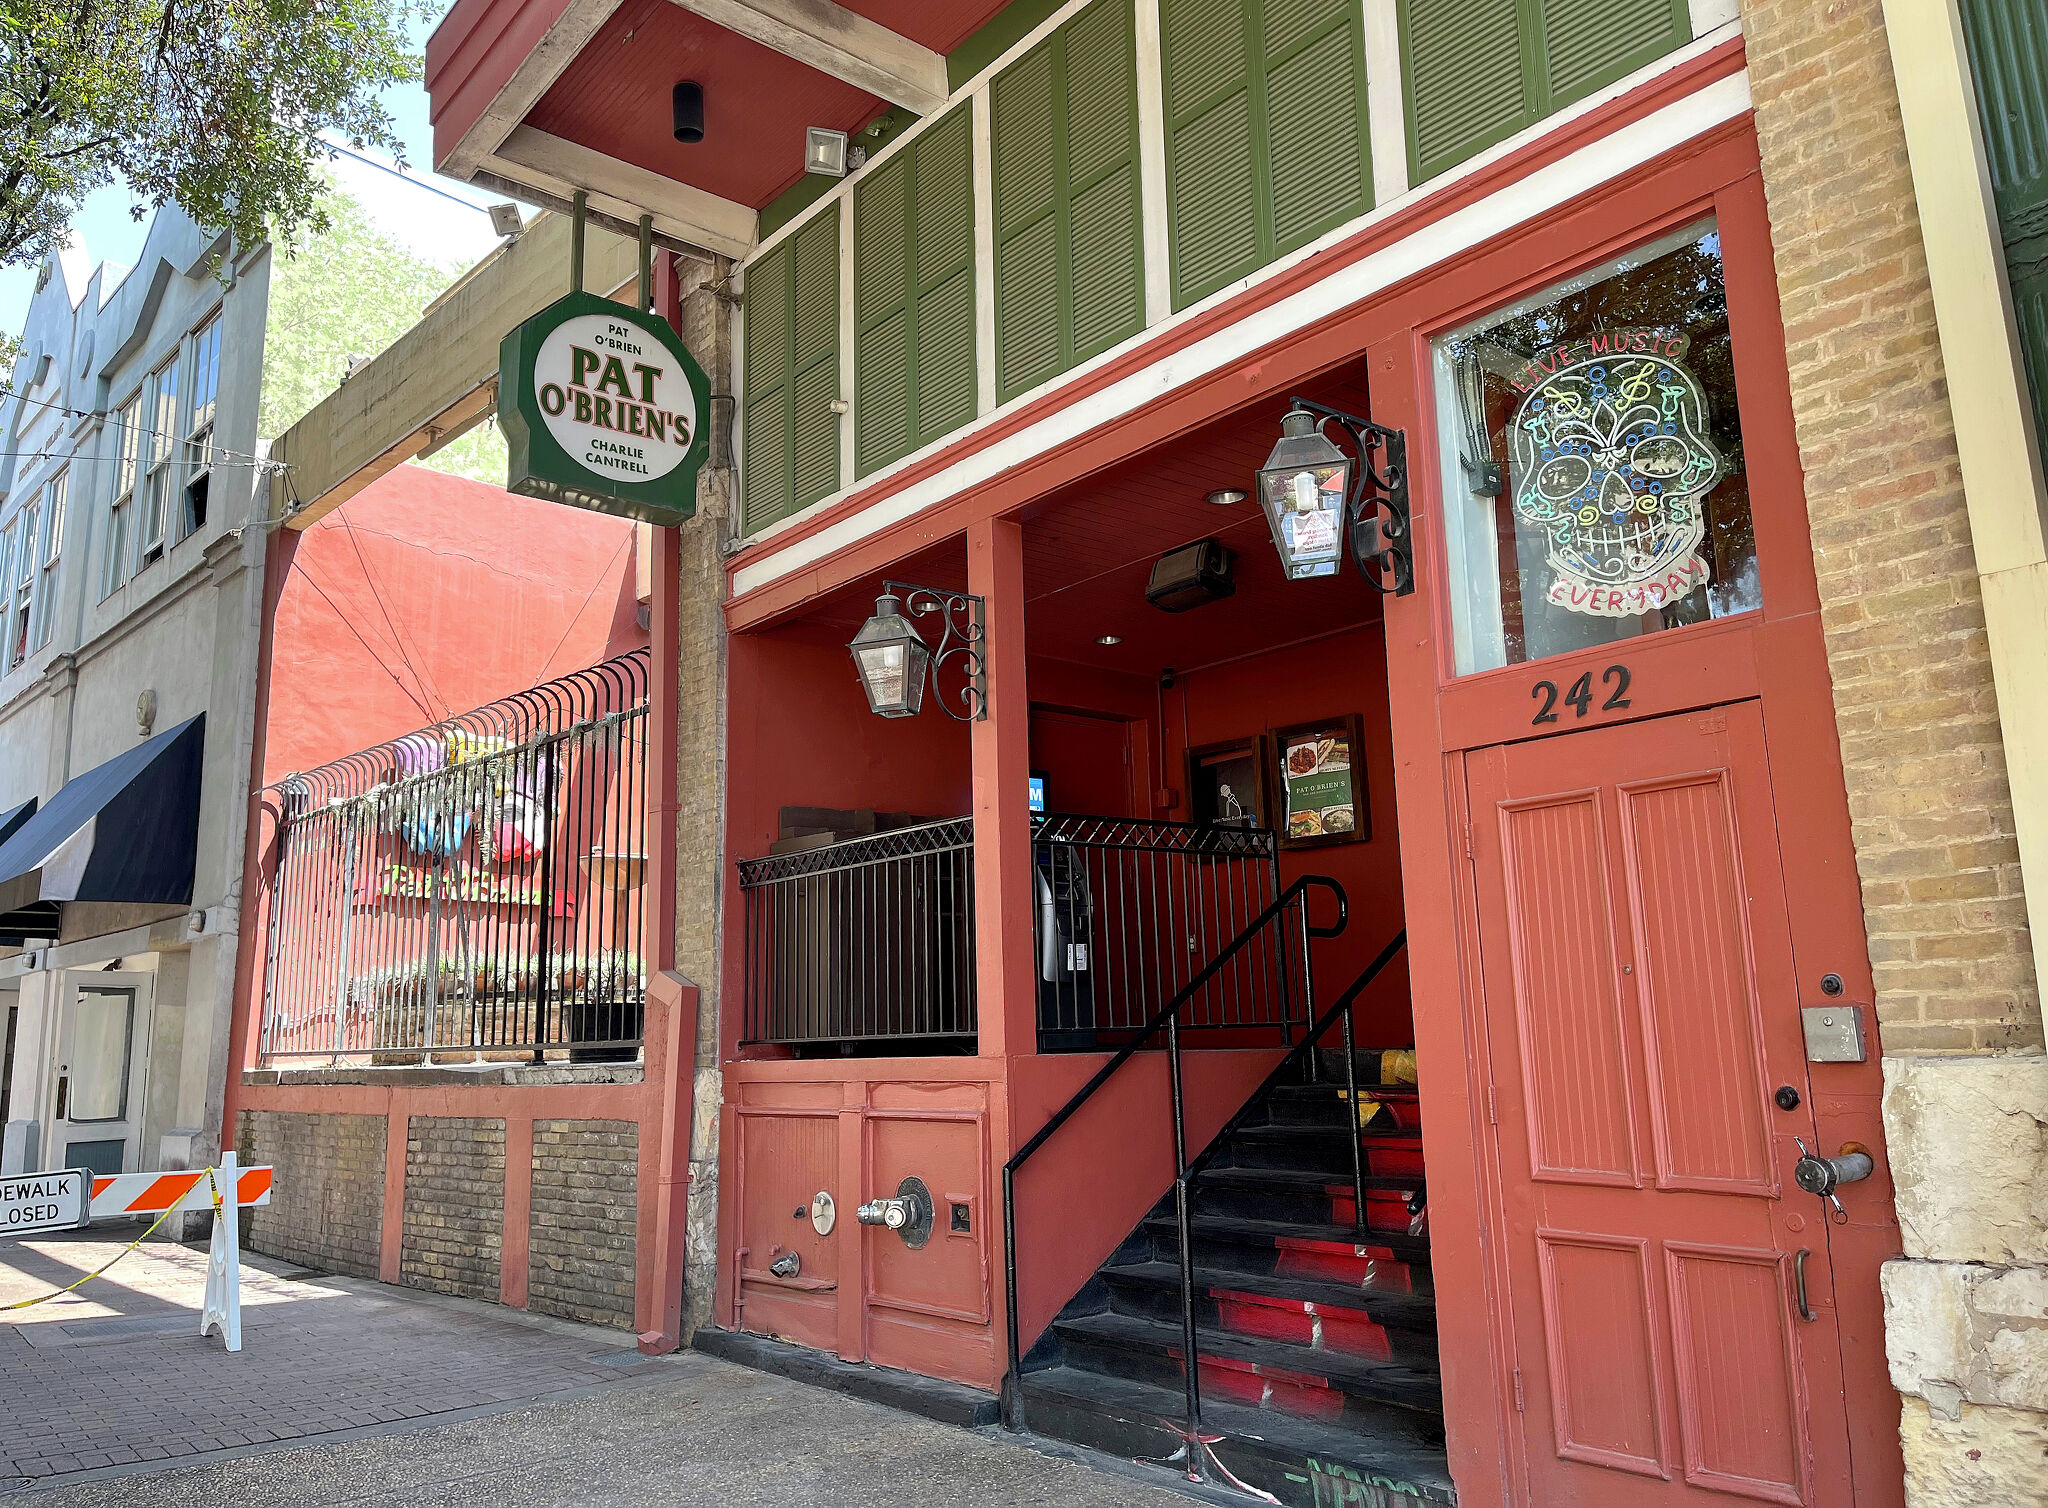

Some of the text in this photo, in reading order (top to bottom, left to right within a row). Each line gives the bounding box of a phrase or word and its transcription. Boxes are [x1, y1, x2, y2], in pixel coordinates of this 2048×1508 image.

[608, 323, 629, 338] PAT
[594, 334, 642, 356] O'BRIEN
[1511, 331, 1684, 394] LIVE MUSIC
[569, 344, 664, 406] PAT
[538, 382, 692, 448] O'BRIEN'S
[590, 438, 644, 460] CHARLIE
[585, 452, 649, 475] CANTRELL
[1551, 557, 1704, 612] EVERYDAY
[1531, 664, 1633, 727] 242
[1296, 786, 1309, 794] PAT
[0, 1178, 70, 1202] EWALK
